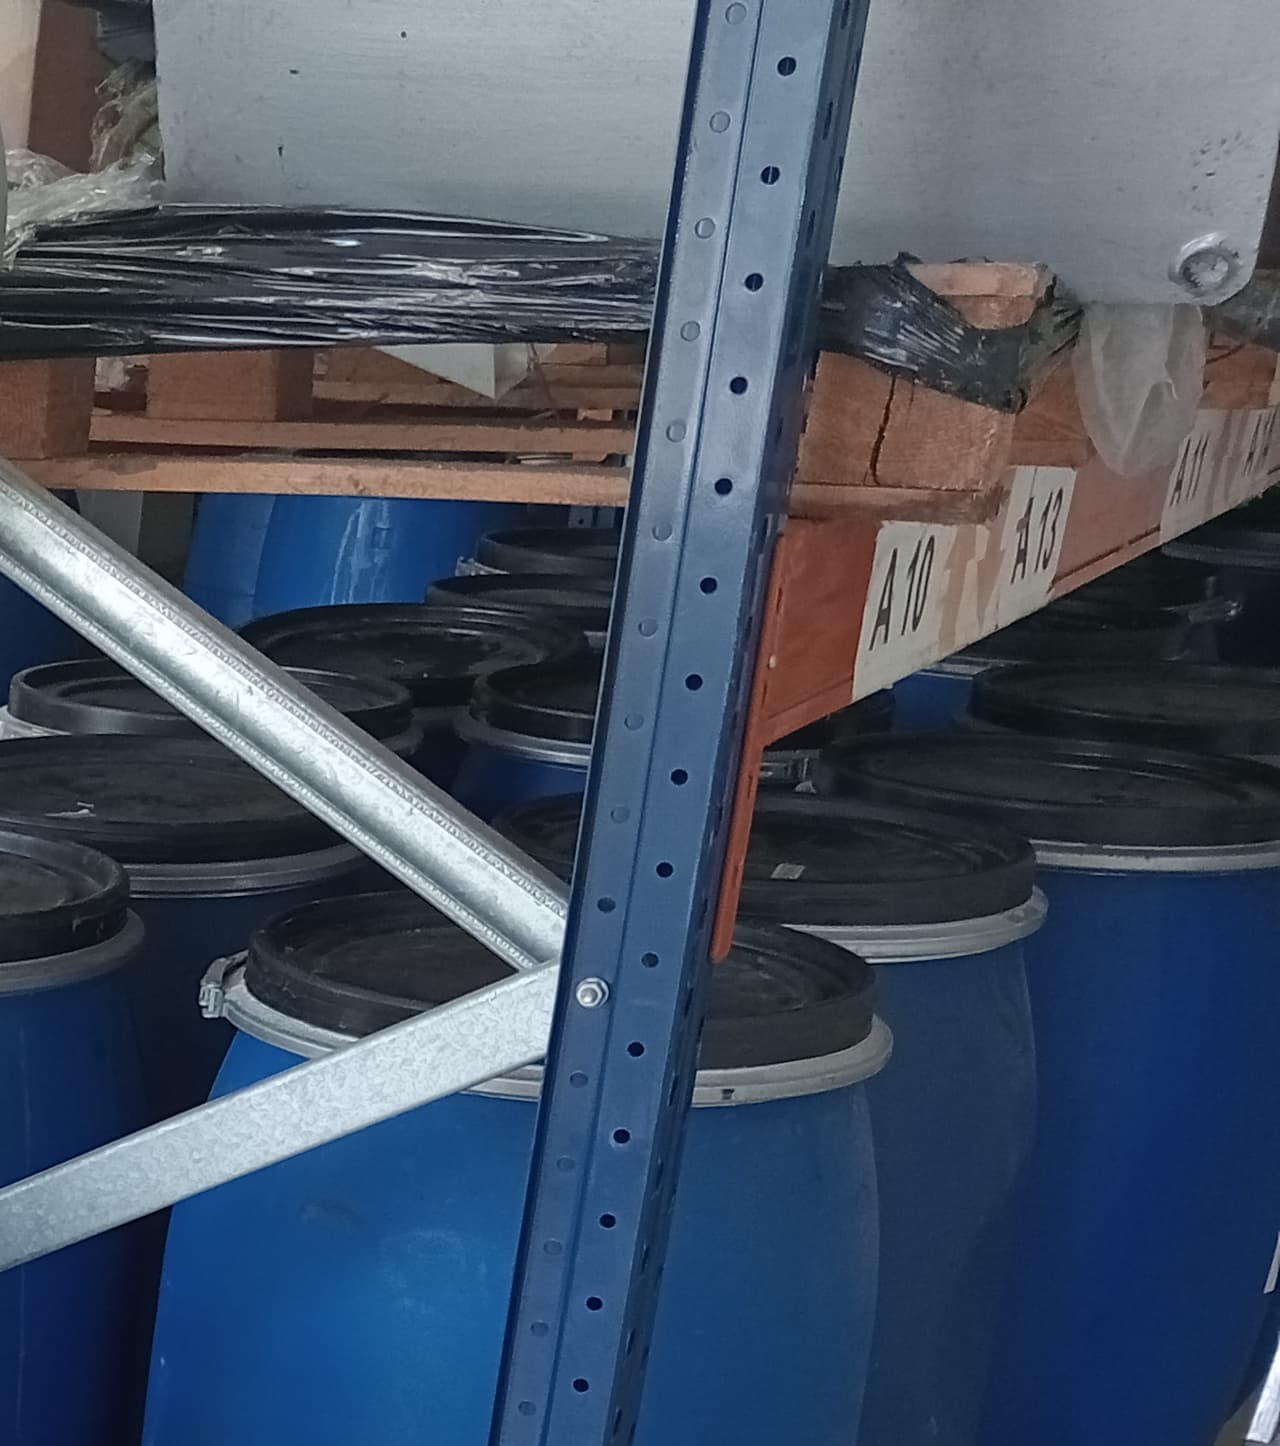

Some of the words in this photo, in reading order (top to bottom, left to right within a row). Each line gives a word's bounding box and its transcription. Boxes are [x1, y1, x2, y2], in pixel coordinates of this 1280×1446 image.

[1169, 438, 1192, 507] A
[1186, 432, 1210, 501] 11
[1010, 496, 1034, 585] A
[1033, 487, 1063, 573] 13
[869, 547, 897, 652] A
[901, 535, 936, 636] 10
